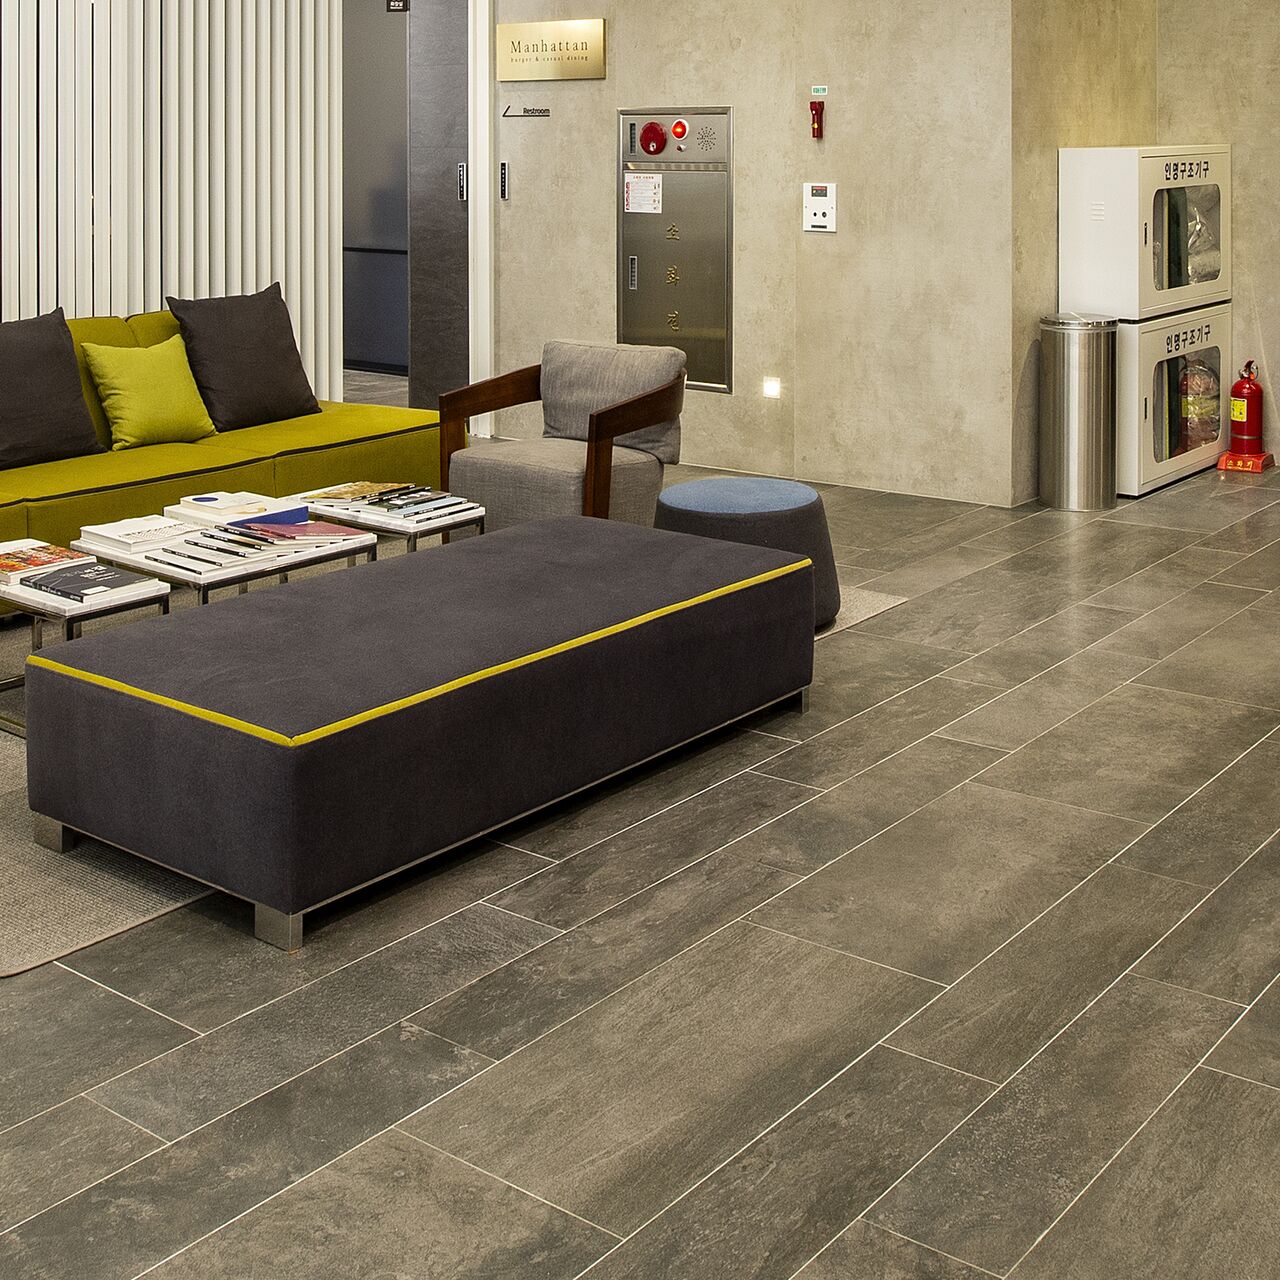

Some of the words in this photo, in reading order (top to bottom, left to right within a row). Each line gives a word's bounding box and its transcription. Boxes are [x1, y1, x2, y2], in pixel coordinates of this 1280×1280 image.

[510, 39, 588, 53] Manhattan
[522, 107, 550, 115] Restroom
[1164, 160, 1210, 181] 인명구조기구
[1166, 324, 1211, 354] 인명구조기구
